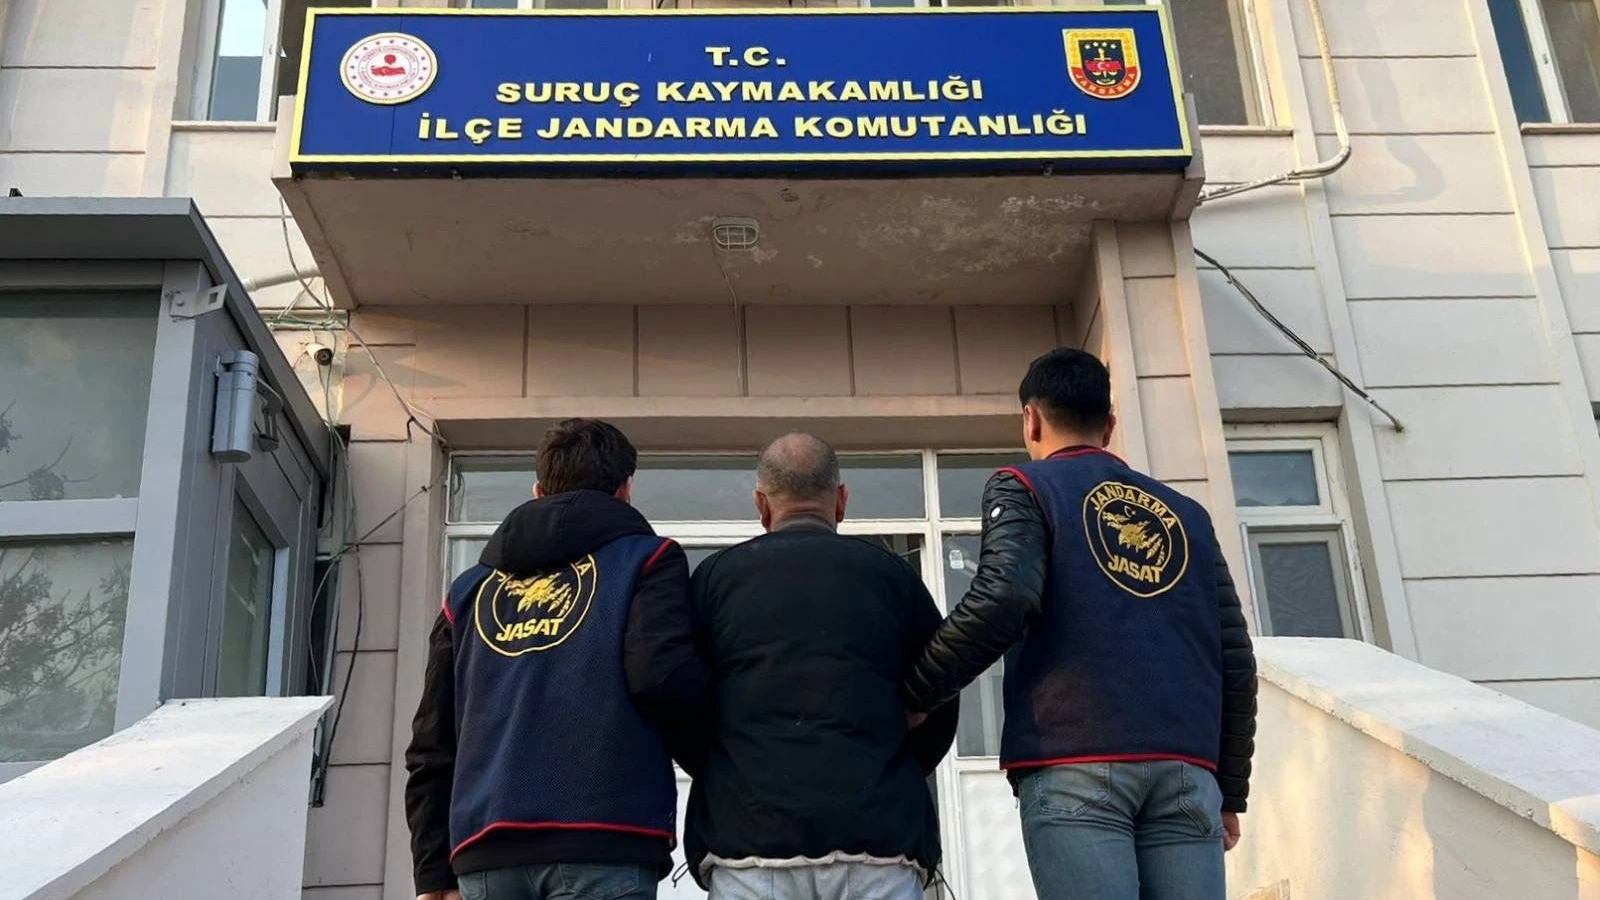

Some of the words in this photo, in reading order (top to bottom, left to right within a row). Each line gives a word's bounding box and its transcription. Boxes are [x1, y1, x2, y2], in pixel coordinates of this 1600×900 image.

[705, 46, 786, 66] T.C.
[495, 82, 640, 107] SURUÇ
[657, 75, 983, 102] KAYMAKAMLIĞI
[418, 112, 522, 144] İLÇE
[536, 117, 779, 139] JANDARMA
[794, 109, 1087, 138] KOMUTANLIĞI
[1090, 485, 1177, 532] JANDARMA
[1108, 554, 1164, 584] JASAT
[495, 617, 565, 642] JASAT
